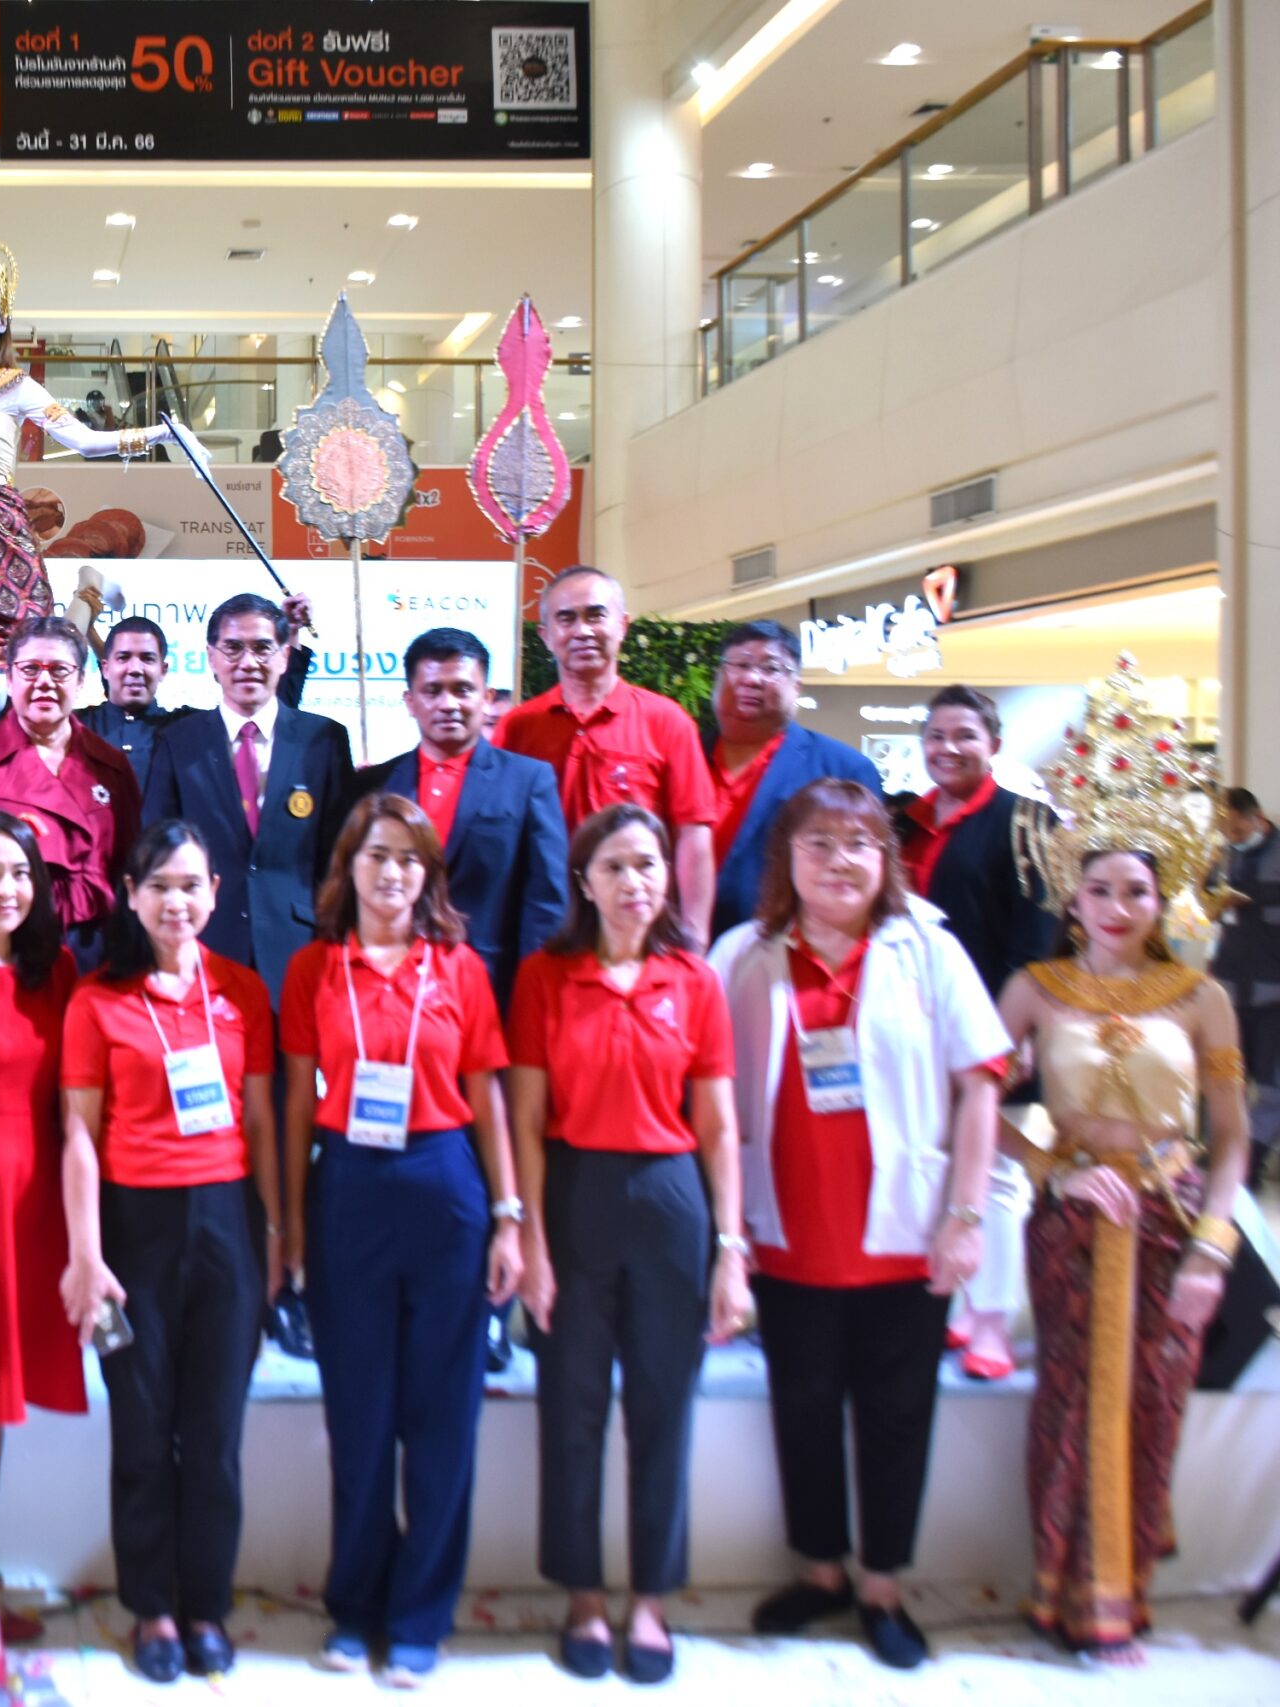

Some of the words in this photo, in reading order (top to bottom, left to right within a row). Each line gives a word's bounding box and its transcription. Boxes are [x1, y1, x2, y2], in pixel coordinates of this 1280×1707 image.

[70, 32, 79, 51] 1
[301, 32, 315, 51] 2
[322, 29, 390, 52] รับฟรี!
[247, 57, 310, 87] Gift
[319, 57, 464, 87] Voucher
[16, 128, 50, 150] วันนี้
[69, 133, 87, 150] 31
[96, 132, 128, 150] มี.ค.
[135, 133, 155, 150] 66
[180, 521, 233, 534] TRANS
[237, 521, 265, 534] AT
[388, 596, 488, 610] SEACON
